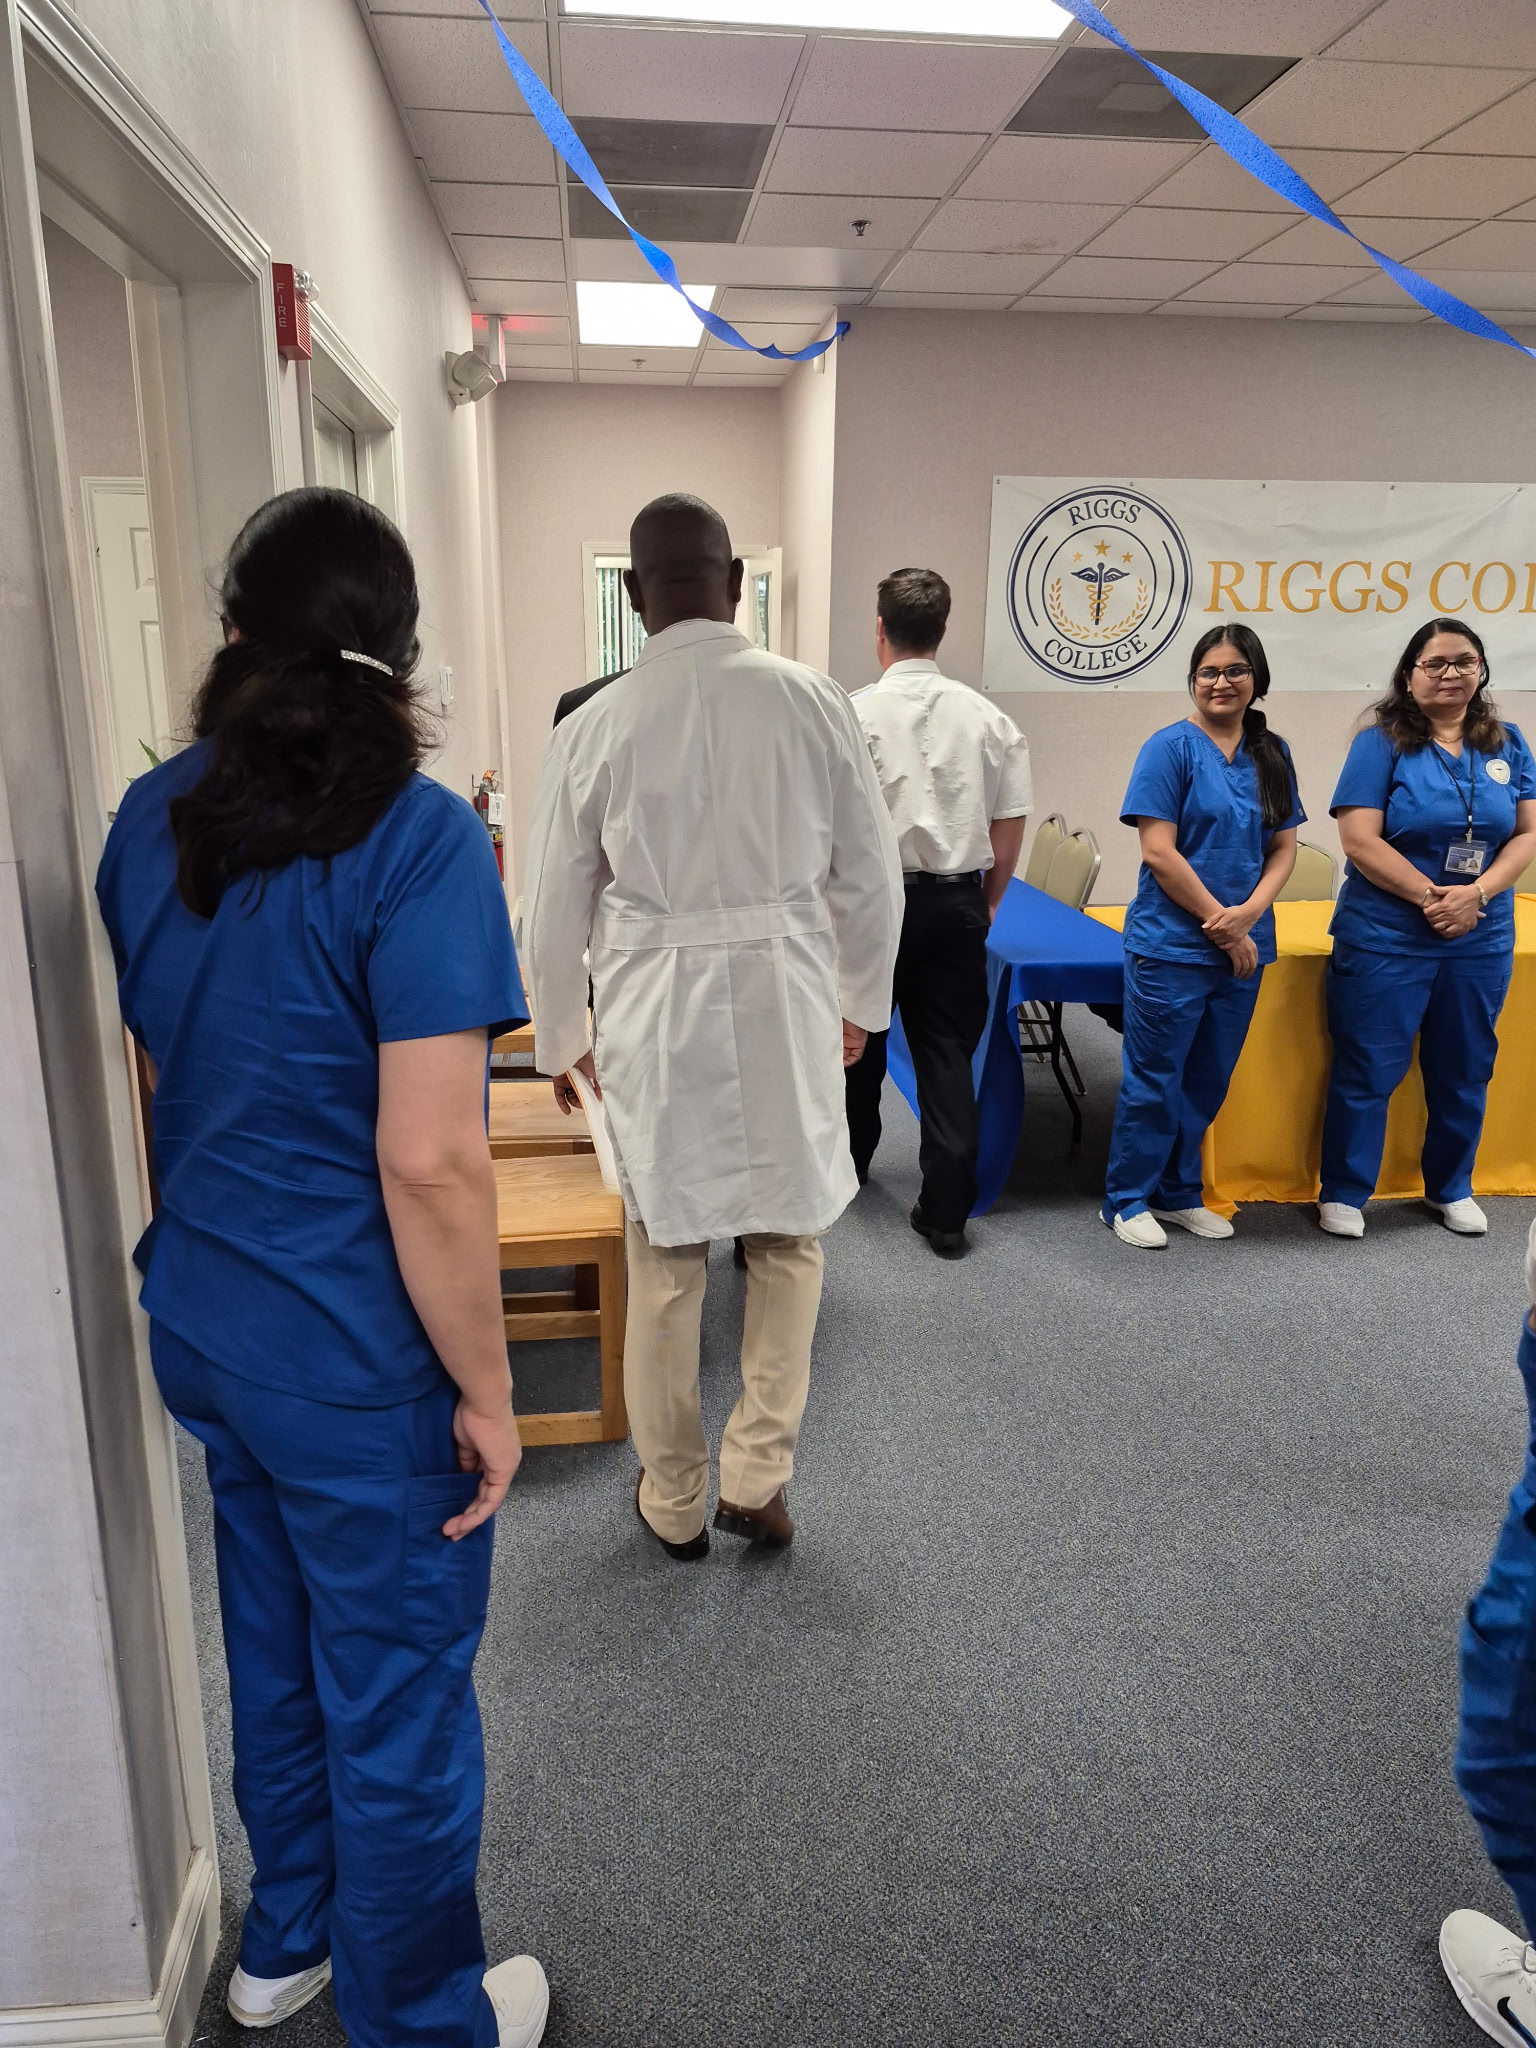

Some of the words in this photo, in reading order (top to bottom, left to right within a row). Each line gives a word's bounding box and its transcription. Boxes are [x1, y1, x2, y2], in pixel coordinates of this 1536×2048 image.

[276, 282, 287, 328] FIRE
[1067, 498, 1141, 526] RIGGS
[1203, 560, 1411, 613] RIGGS
[1044, 633, 1148, 671] COLLEGE
